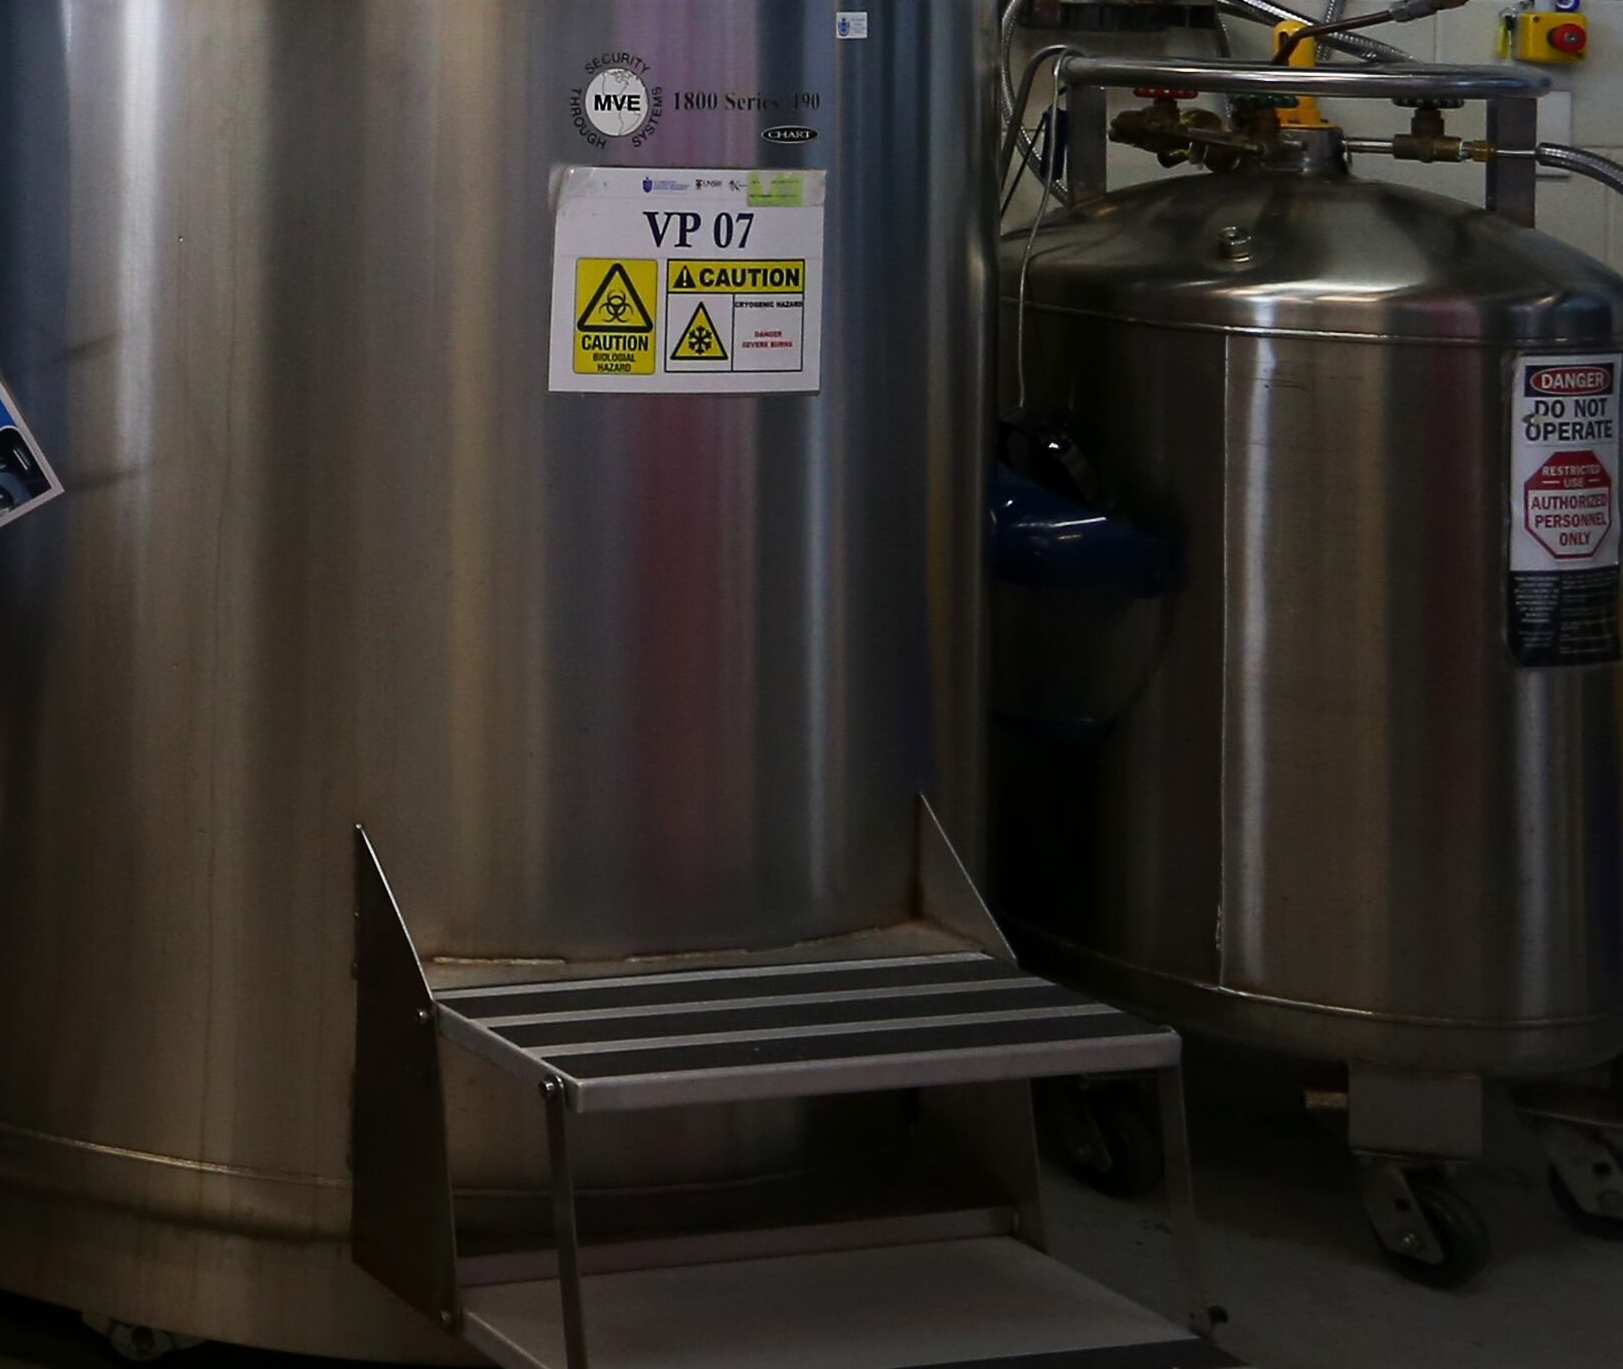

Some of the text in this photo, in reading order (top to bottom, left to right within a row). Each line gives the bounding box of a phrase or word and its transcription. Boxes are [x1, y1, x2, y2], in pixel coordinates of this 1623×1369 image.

[585, 52, 650, 75] SECURITY
[594, 94, 641, 112] MVE
[673, 92, 718, 111] 1800
[724, 92, 779, 111] Series
[571, 87, 607, 150] THROUGH
[633, 86, 663, 148] SYSTEMS
[767, 129, 812, 139] CHART
[643, 211, 755, 249] VP 07
[699, 268, 800, 287] CAUTION
[582, 334, 649, 352] CAUTION
[597, 363, 632, 373] HAZARD
[1541, 371, 1604, 390] DANGER
[1534, 398, 1608, 419] DO NOT
[1525, 419, 1613, 442] OPERATE
[1541, 464, 1601, 476] RESTRICTED
[1564, 477, 1585, 488] USE
[1531, 492, 1607, 511] AUTHORIZED
[1534, 512, 1606, 529] PERSONNEL
[1559, 532, 1592, 547] ONLY
